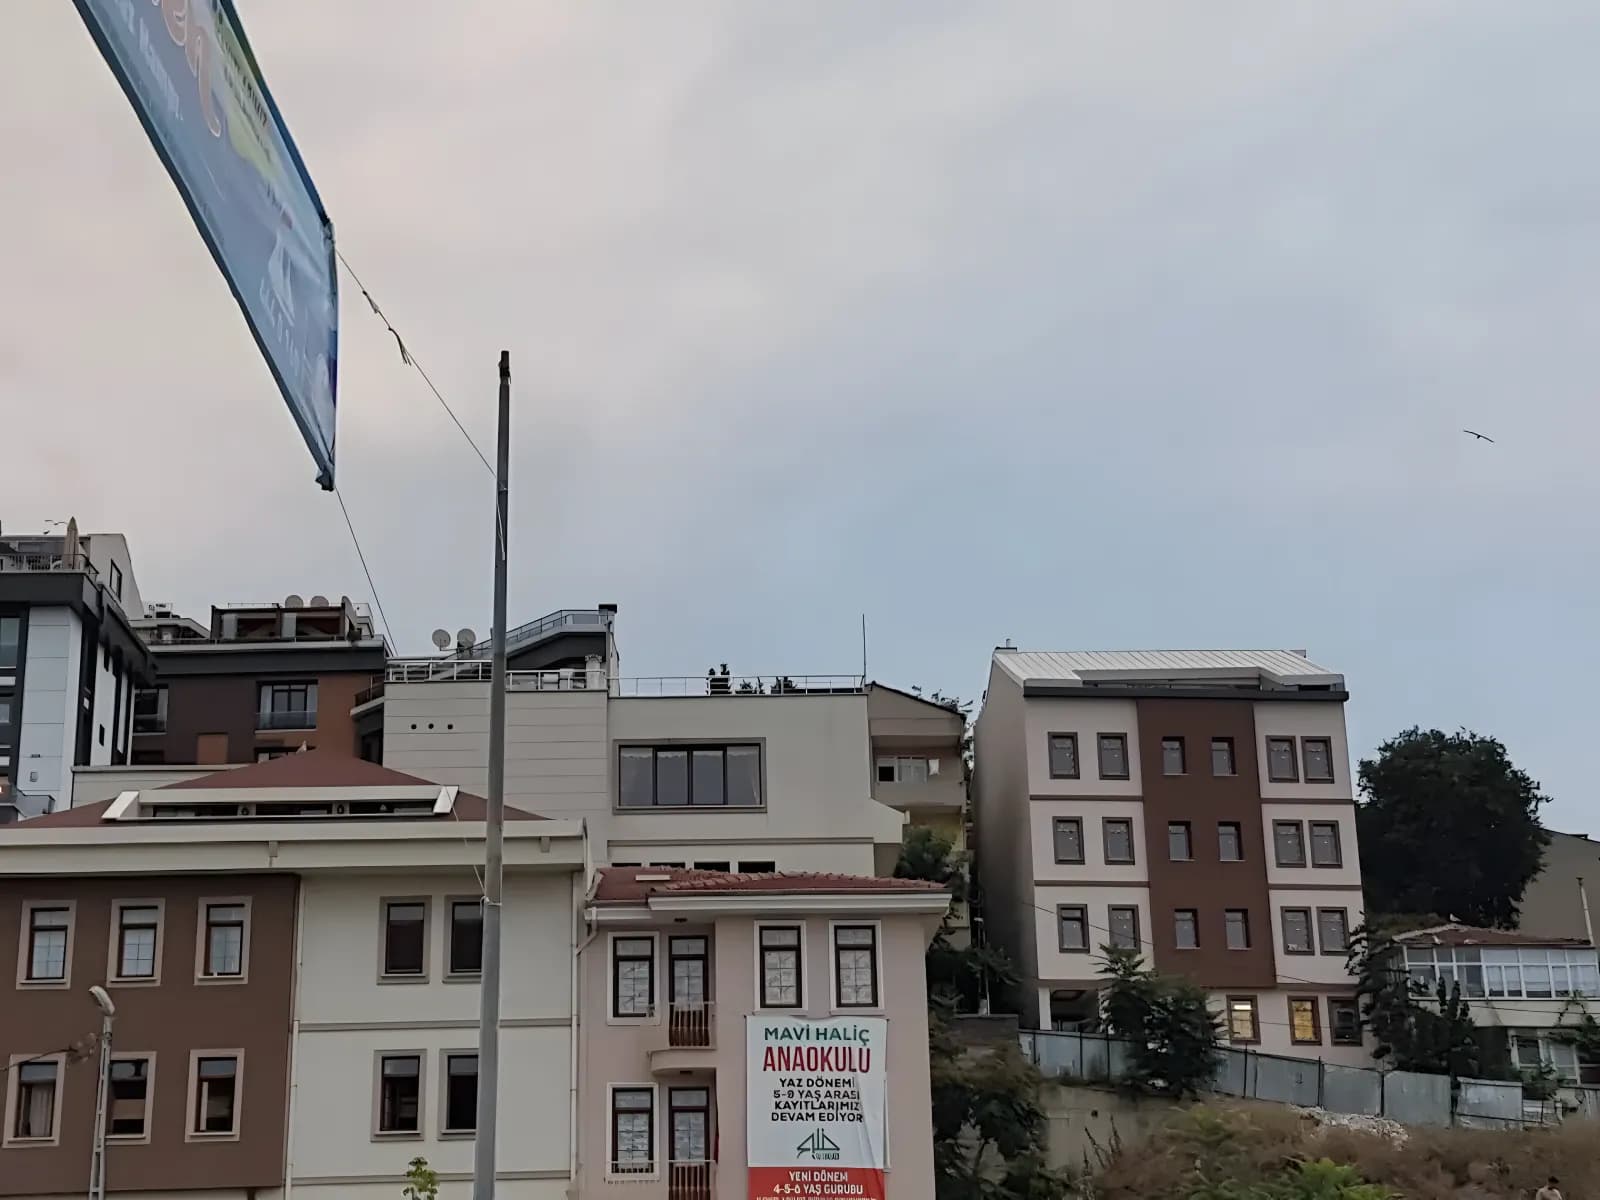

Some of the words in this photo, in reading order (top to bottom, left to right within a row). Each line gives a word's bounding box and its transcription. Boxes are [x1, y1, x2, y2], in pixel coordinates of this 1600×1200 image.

[764, 1024, 810, 1041] MAVİ
[815, 1024, 870, 1046] HALİÇ
[763, 1046, 870, 1073] ANAOKULU
[779, 1078, 803, 1088] YAZ
[798, 1090, 821, 1102] YAŞ
[774, 1101, 860, 1110] KAYITLARIMIZ
[771, 1112, 815, 1121] DEVAM
[789, 1170, 811, 1182] YENİ
[814, 1169, 848, 1182] DÖNEM
[804, 1184, 821, 1195] YAŞ
